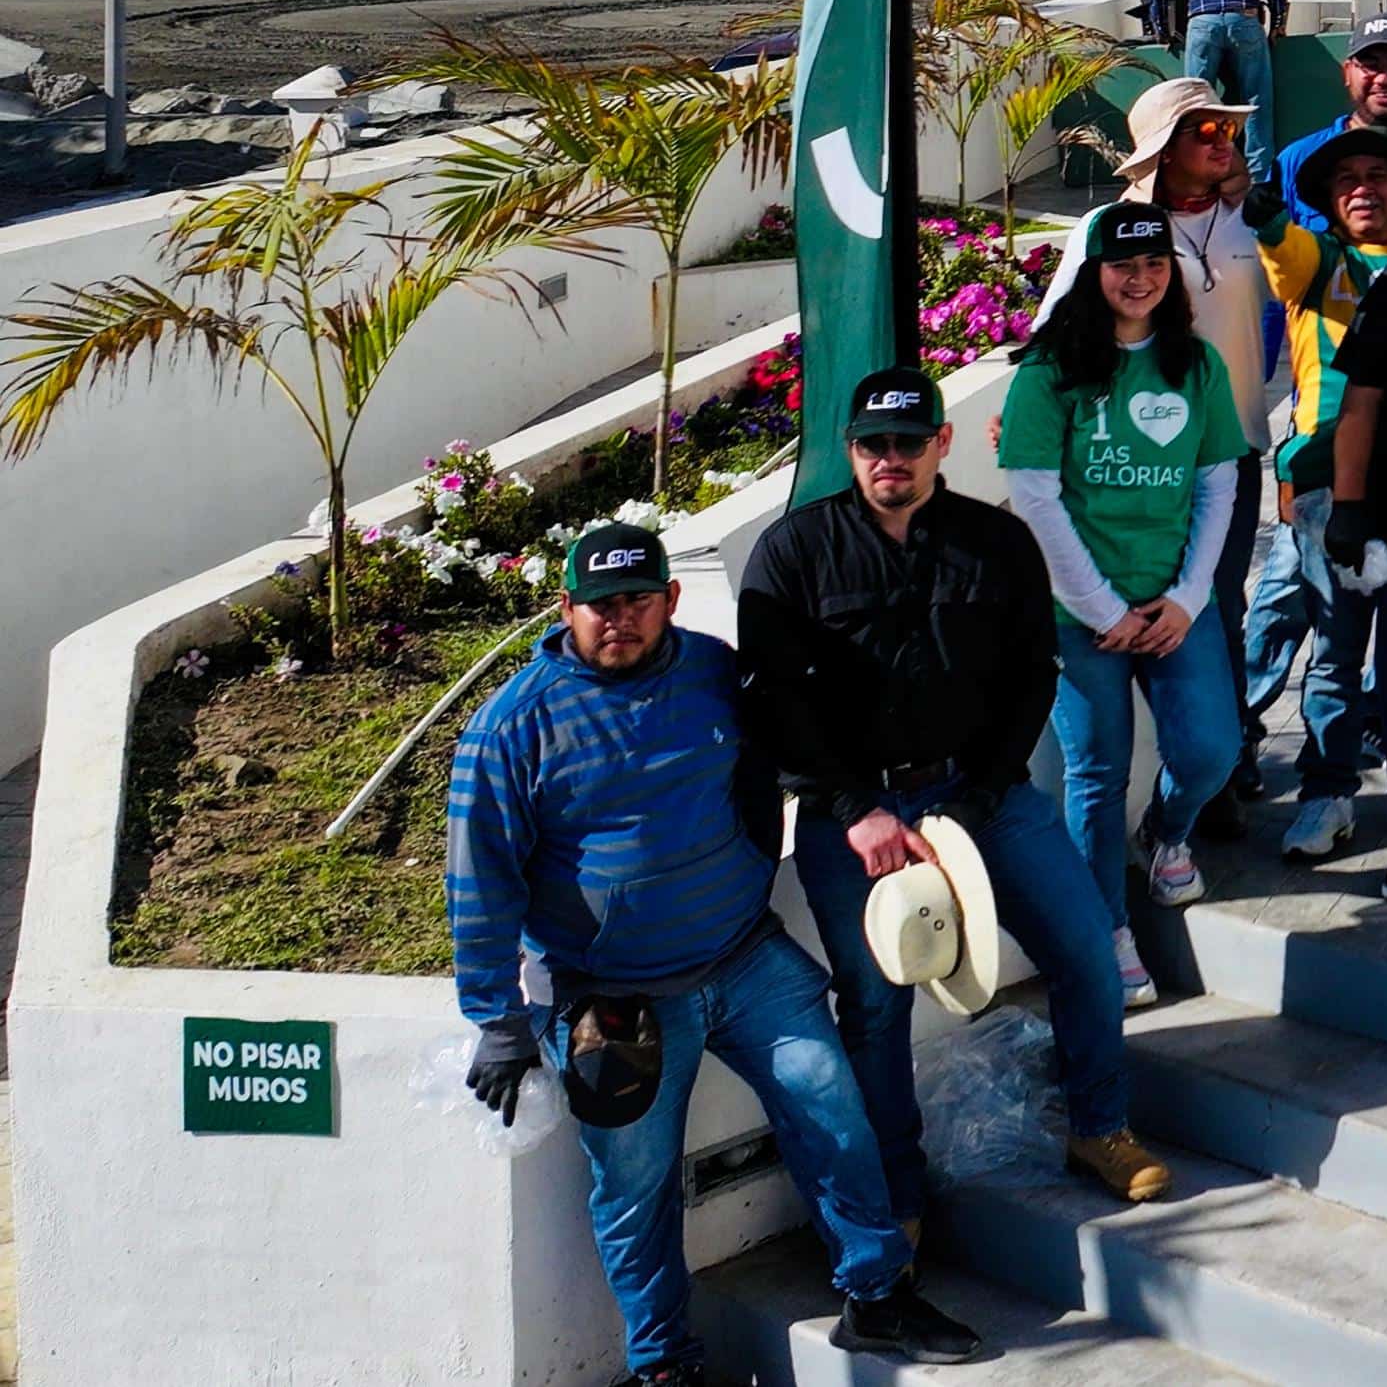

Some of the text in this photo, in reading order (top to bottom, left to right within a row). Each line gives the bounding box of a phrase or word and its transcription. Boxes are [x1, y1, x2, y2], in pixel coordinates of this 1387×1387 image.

[1091, 395, 1112, 442] I
[1088, 445, 1131, 464] LAS
[1084, 464, 1186, 487] GLORIAS
[193, 1040, 321, 1070] NO PISAR
[208, 1075, 308, 1104] MUROS
